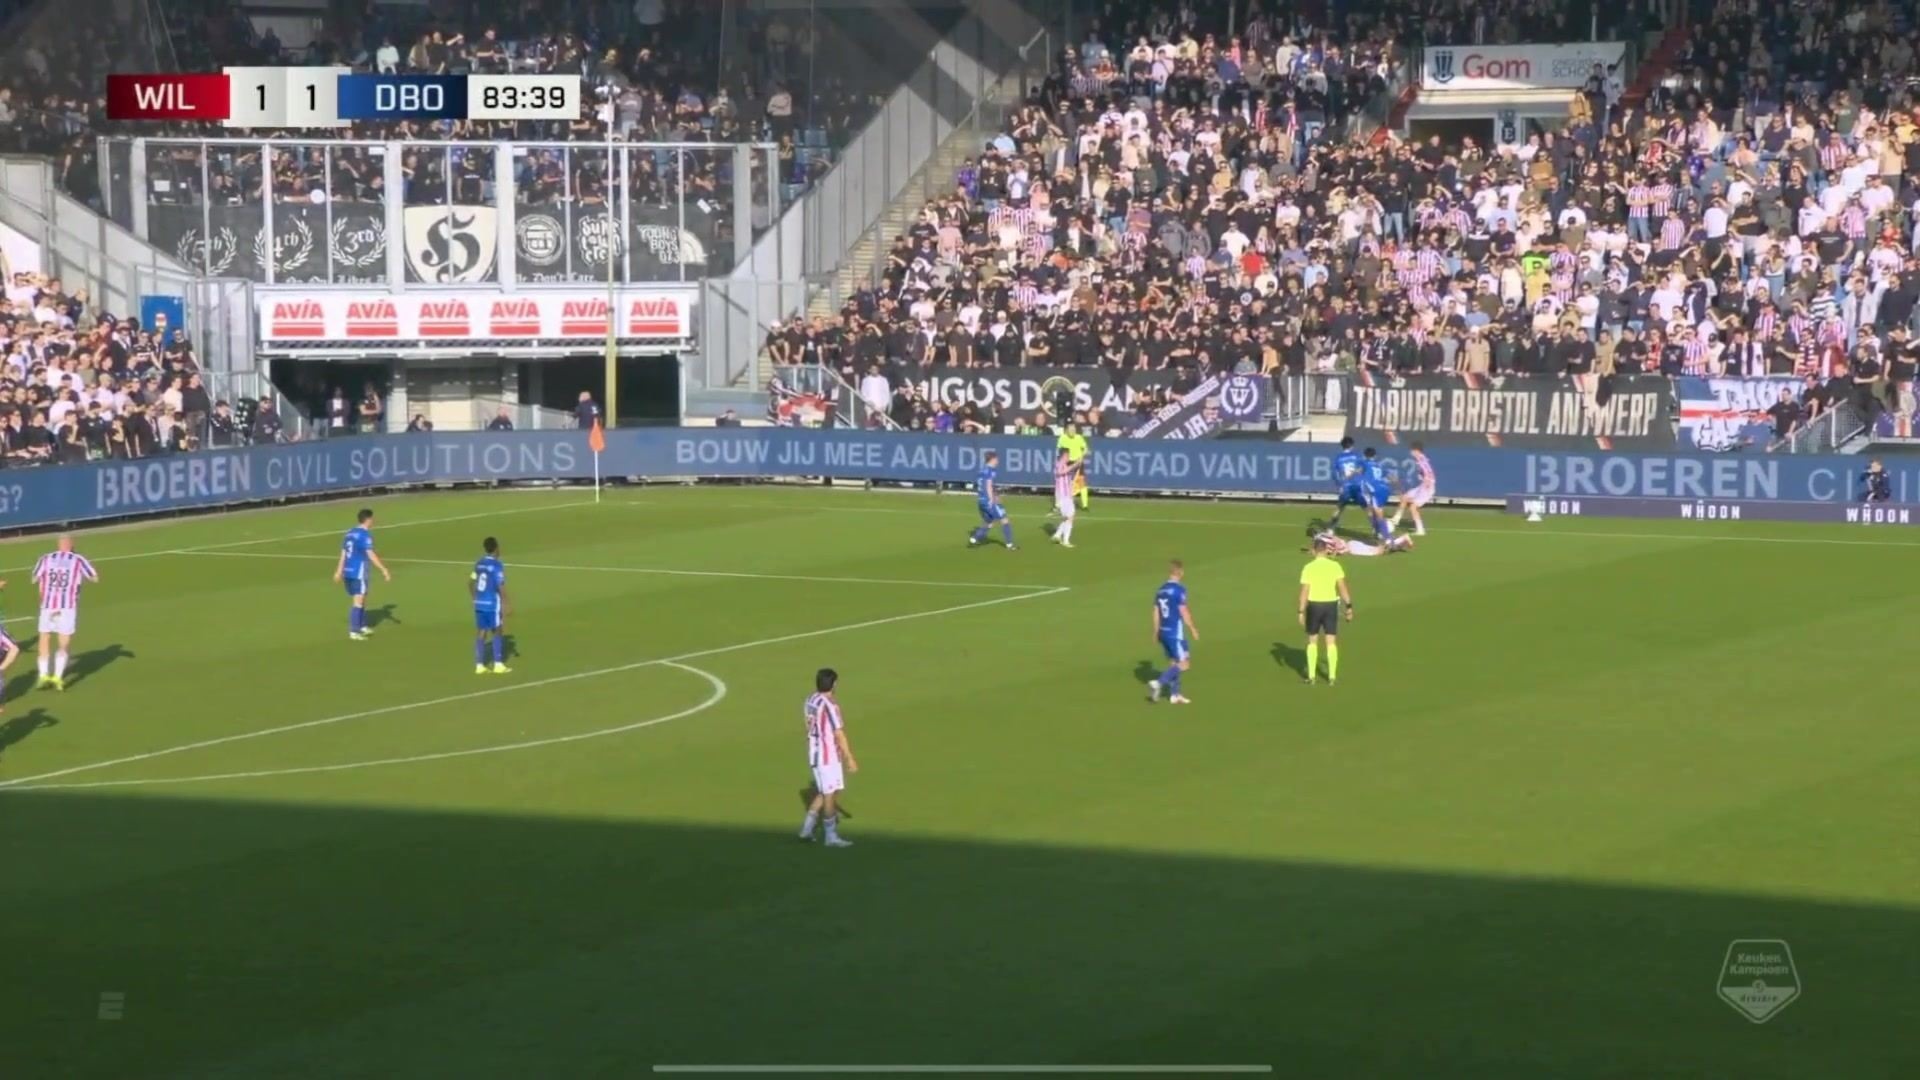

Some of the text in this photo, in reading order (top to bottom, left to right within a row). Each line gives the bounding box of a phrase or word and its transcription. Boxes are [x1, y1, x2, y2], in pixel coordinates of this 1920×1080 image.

[1463, 54, 1530, 78] Gom
[344, 229, 375, 253] 3rd
[1230, 388, 1249, 406] W
[1353, 386, 1442, 431] TILBURG
[1450, 389, 1540, 433] BRISTOL
[676, 439, 770, 464] BOUW
[778, 443, 816, 466] JIJ
[824, 443, 884, 467] MEE
[890, 445, 949, 470] AAN
[1006, 447, 1189, 478] BINENSTAD
[1198, 454, 1258, 480] VAN
[1266, 454, 1416, 484] TILBG?
[97, 442, 576, 509] BROEREN CIVIL SOLUTIONS
[1526, 454, 1920, 503] BROEREN CII
[1681, 502, 1740, 520] WHOON
[1847, 506, 1909, 523] WHOON
[346, 541, 353, 557] 3
[478, 573, 487, 592] 6
